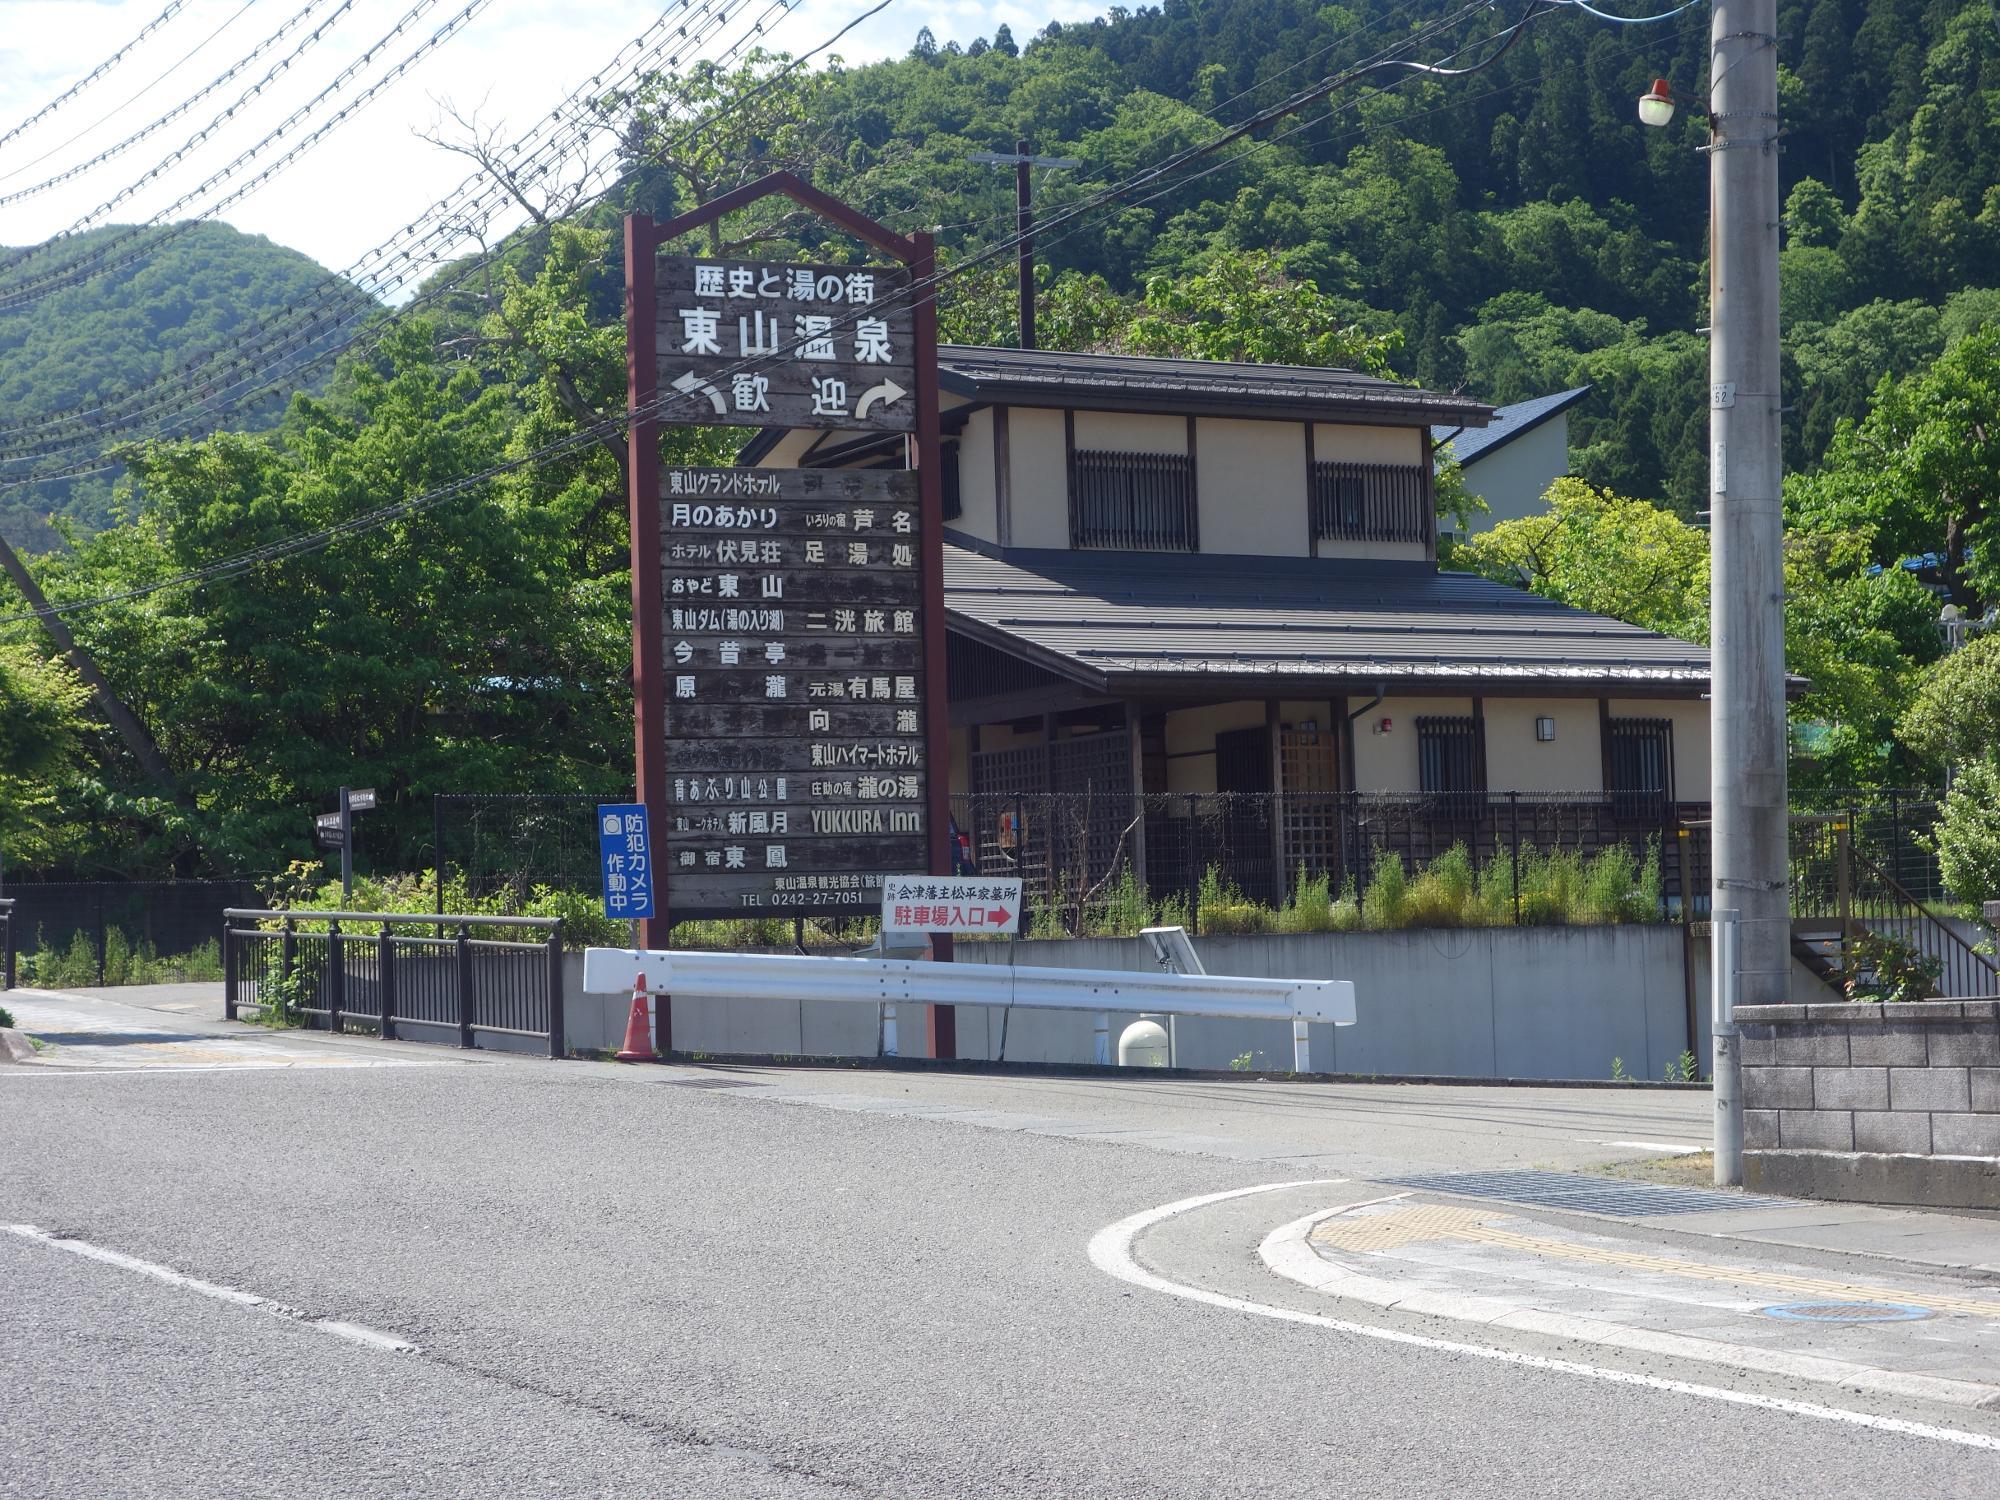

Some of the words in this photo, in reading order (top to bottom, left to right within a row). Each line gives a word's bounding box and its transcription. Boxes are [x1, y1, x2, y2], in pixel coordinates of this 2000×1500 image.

[694, 265, 875, 305] 歴史と湯の街
[679, 306, 893, 364] 東山温泉
[731, 372, 849, 416] 歓迎
[669, 470, 780, 496] 東山グランドホテル
[671, 503, 777, 529] 月のあかり
[805, 513, 846, 528] いろりの宿
[853, 508, 911, 534] 芦名
[671, 544, 711, 560] ホテル
[716, 540, 781, 564] 伏見荘
[805, 540, 912, 567] 足湯処
[671, 578, 713, 594] おやど
[718, 573, 783, 598] 東山
[672, 608, 785, 631] 東山ダム(湯の入り湖)
[673, 640, 786, 665] 今昔亭
[809, 682, 844, 697] 元湯
[848, 676, 916, 699] 有馬屋
[811, 743, 919, 767] 東山ハイマートホテル
[674, 776, 787, 801] 背あぶり山公園
[812, 781, 852, 796] 庄助の宿
[857, 776, 918, 799] 瀧の湯
[728, 811, 788, 834] 新風月
[811, 809, 882, 834] YUKKURA
[889, 809, 920, 832] Inn
[625, 814, 648, 911] 防犯カメラ
[607, 853, 627, 911] 作動中
[898, 884, 1017, 901] 会津藩主松平家墓所
[741, 894, 763, 906] TEL
[772, 892, 862, 905] 0242-27-7051
[894, 905, 984, 927] 駐車場入口
